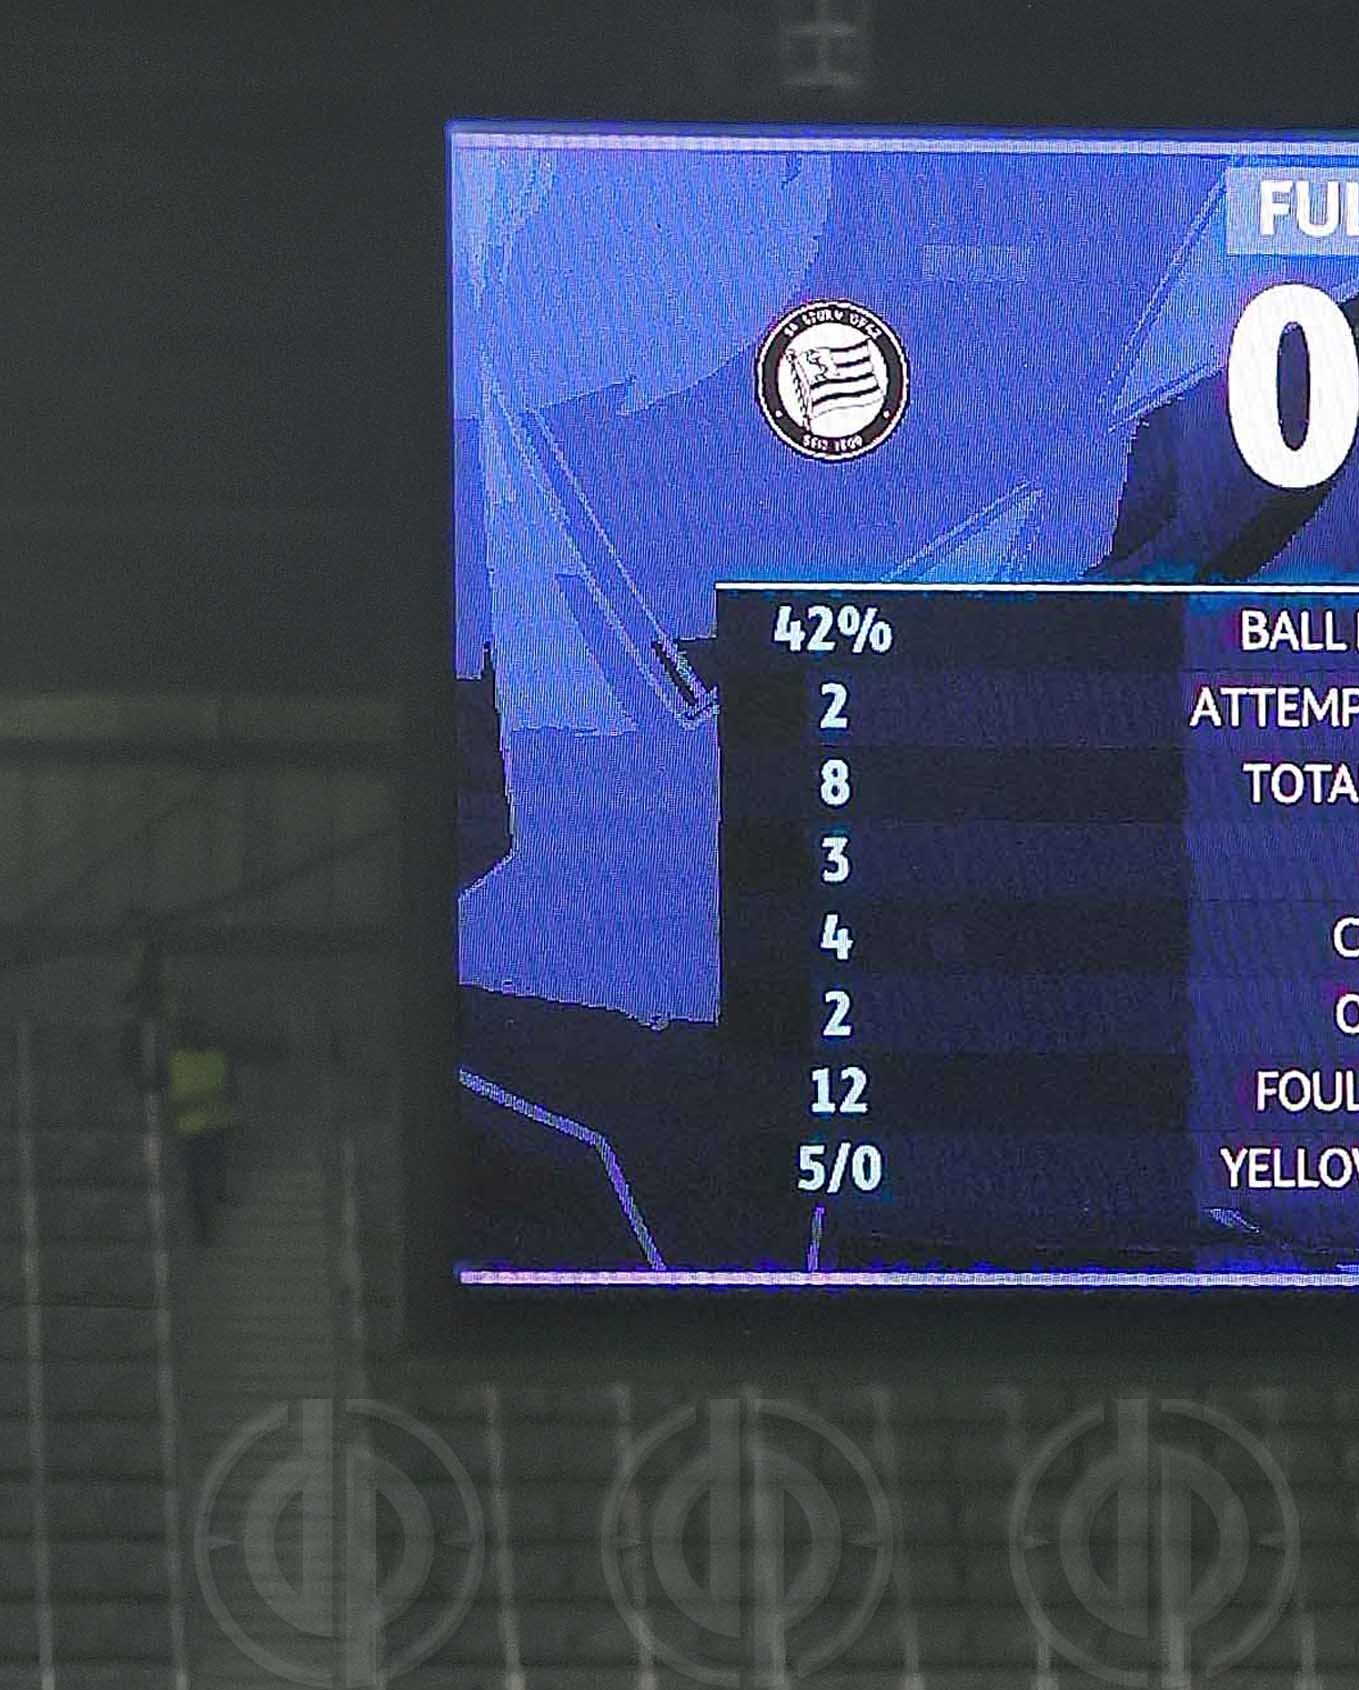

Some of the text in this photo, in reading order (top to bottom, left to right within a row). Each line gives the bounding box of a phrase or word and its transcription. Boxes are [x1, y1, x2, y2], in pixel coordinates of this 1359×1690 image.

[1228, 284, 1359, 488] 0
[773, 604, 893, 654] 42%
[1240, 609, 1347, 654] BALL
[819, 682, 849, 730] 2
[820, 758, 851, 807] 8
[821, 836, 850, 882] 3
[820, 914, 854, 960] 4
[822, 990, 852, 1037] 2
[810, 1066, 869, 1114] 12
[797, 1142, 882, 1193] 5/0
